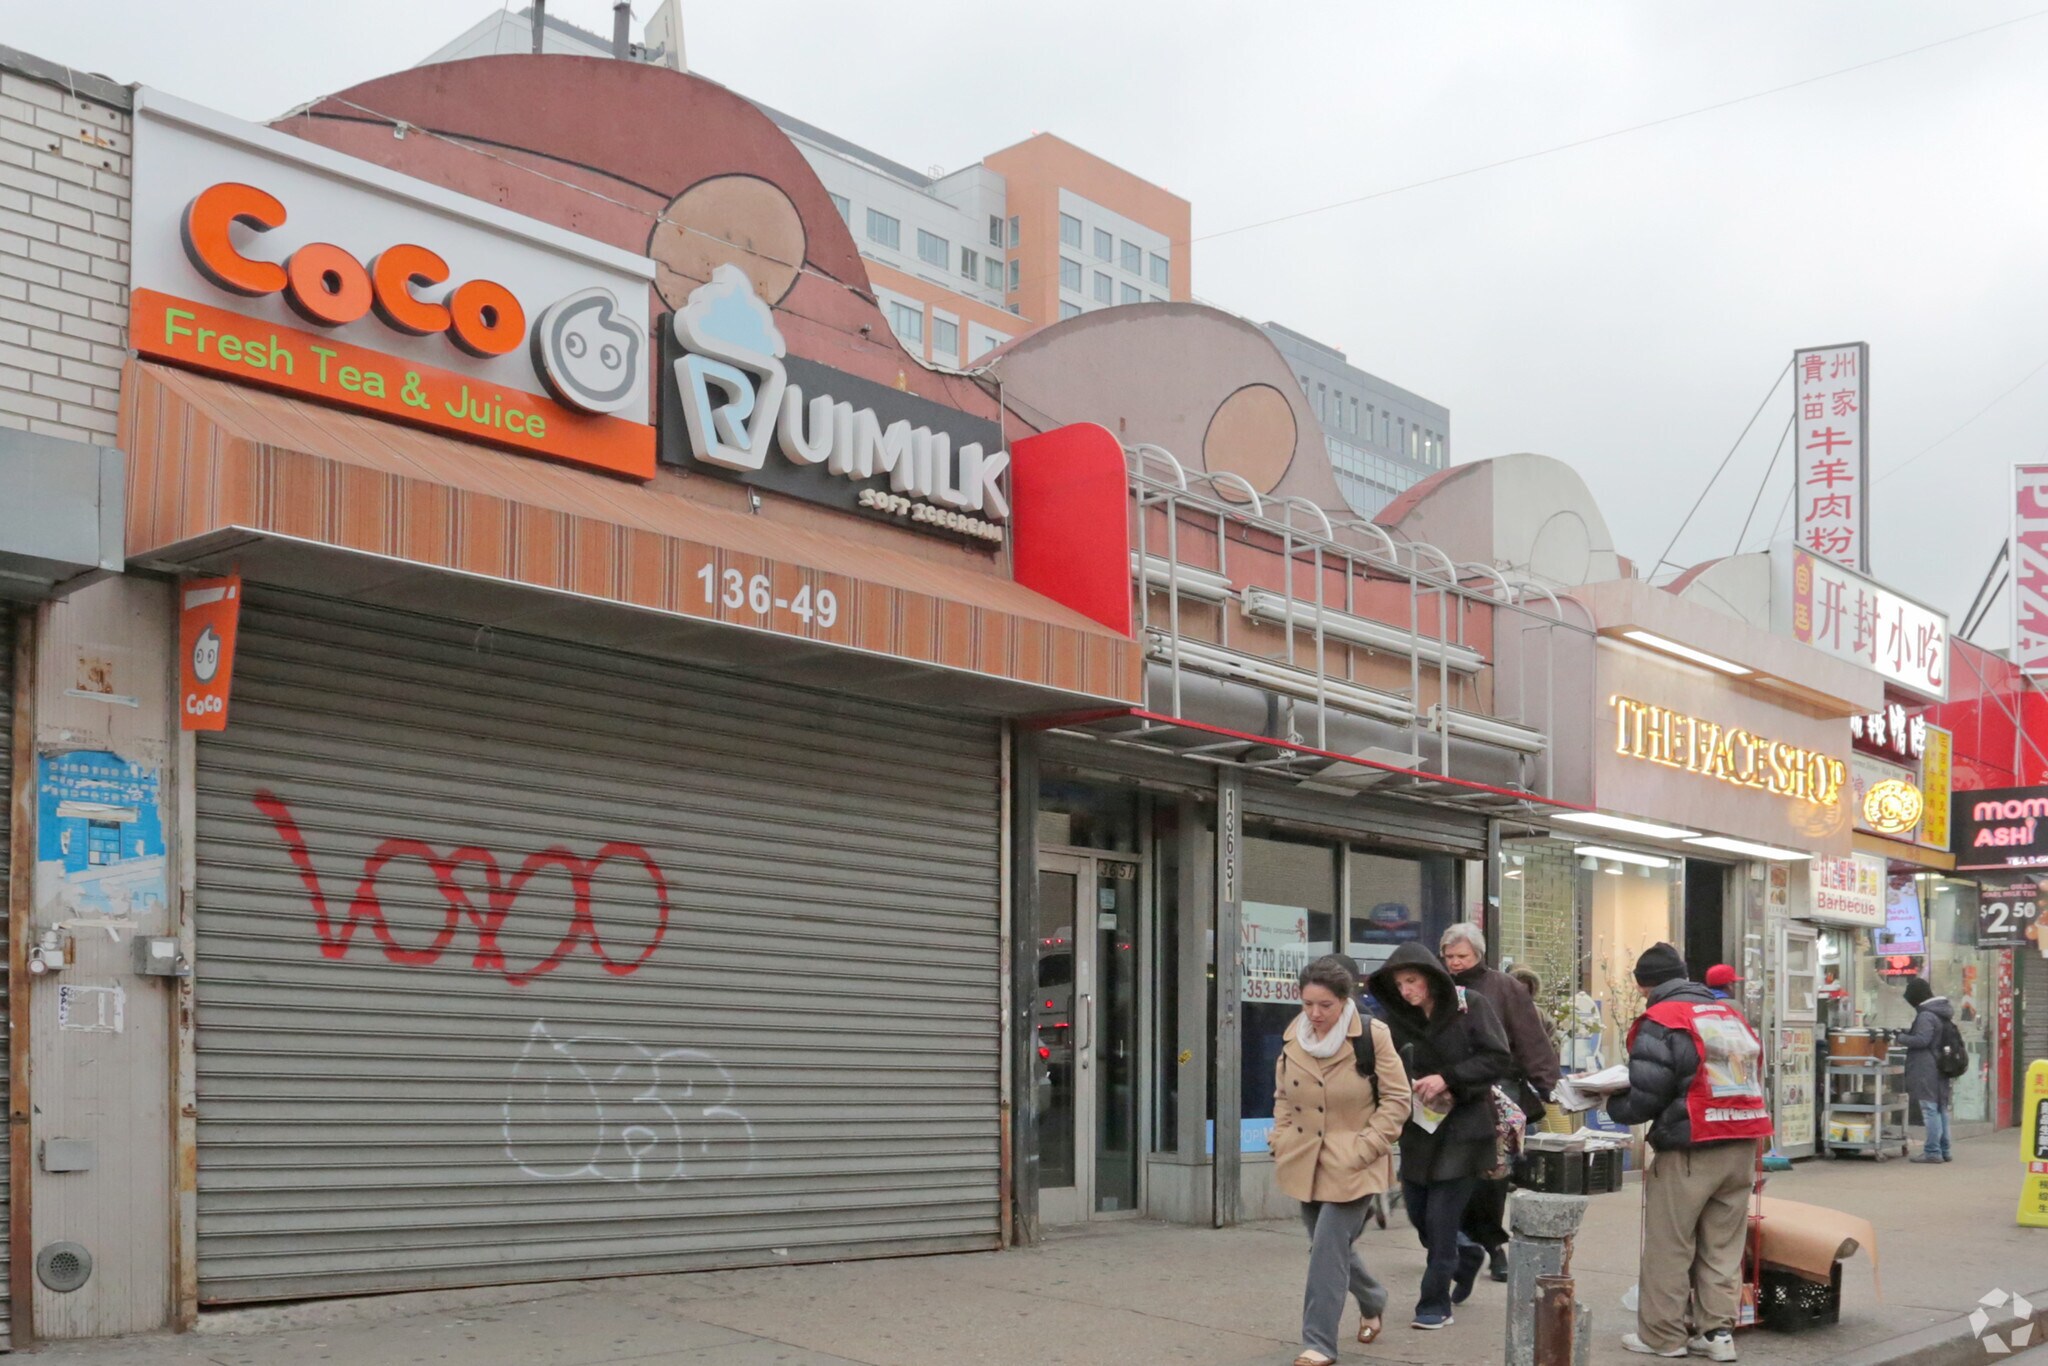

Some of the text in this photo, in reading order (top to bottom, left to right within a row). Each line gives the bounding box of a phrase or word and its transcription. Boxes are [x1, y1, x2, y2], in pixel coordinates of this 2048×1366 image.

[164, 307, 547, 440] Fresh Tea & Juice
[858, 488, 911, 516] SOFT
[1804, 426, 1856, 568] 牛羊肉粉
[698, 563, 838, 628] 136-49
[1817, 576, 1944, 687] 开封小吃
[1817, 891, 1876, 916] Barbecue
[1255, 947, 1276, 978] FOR
